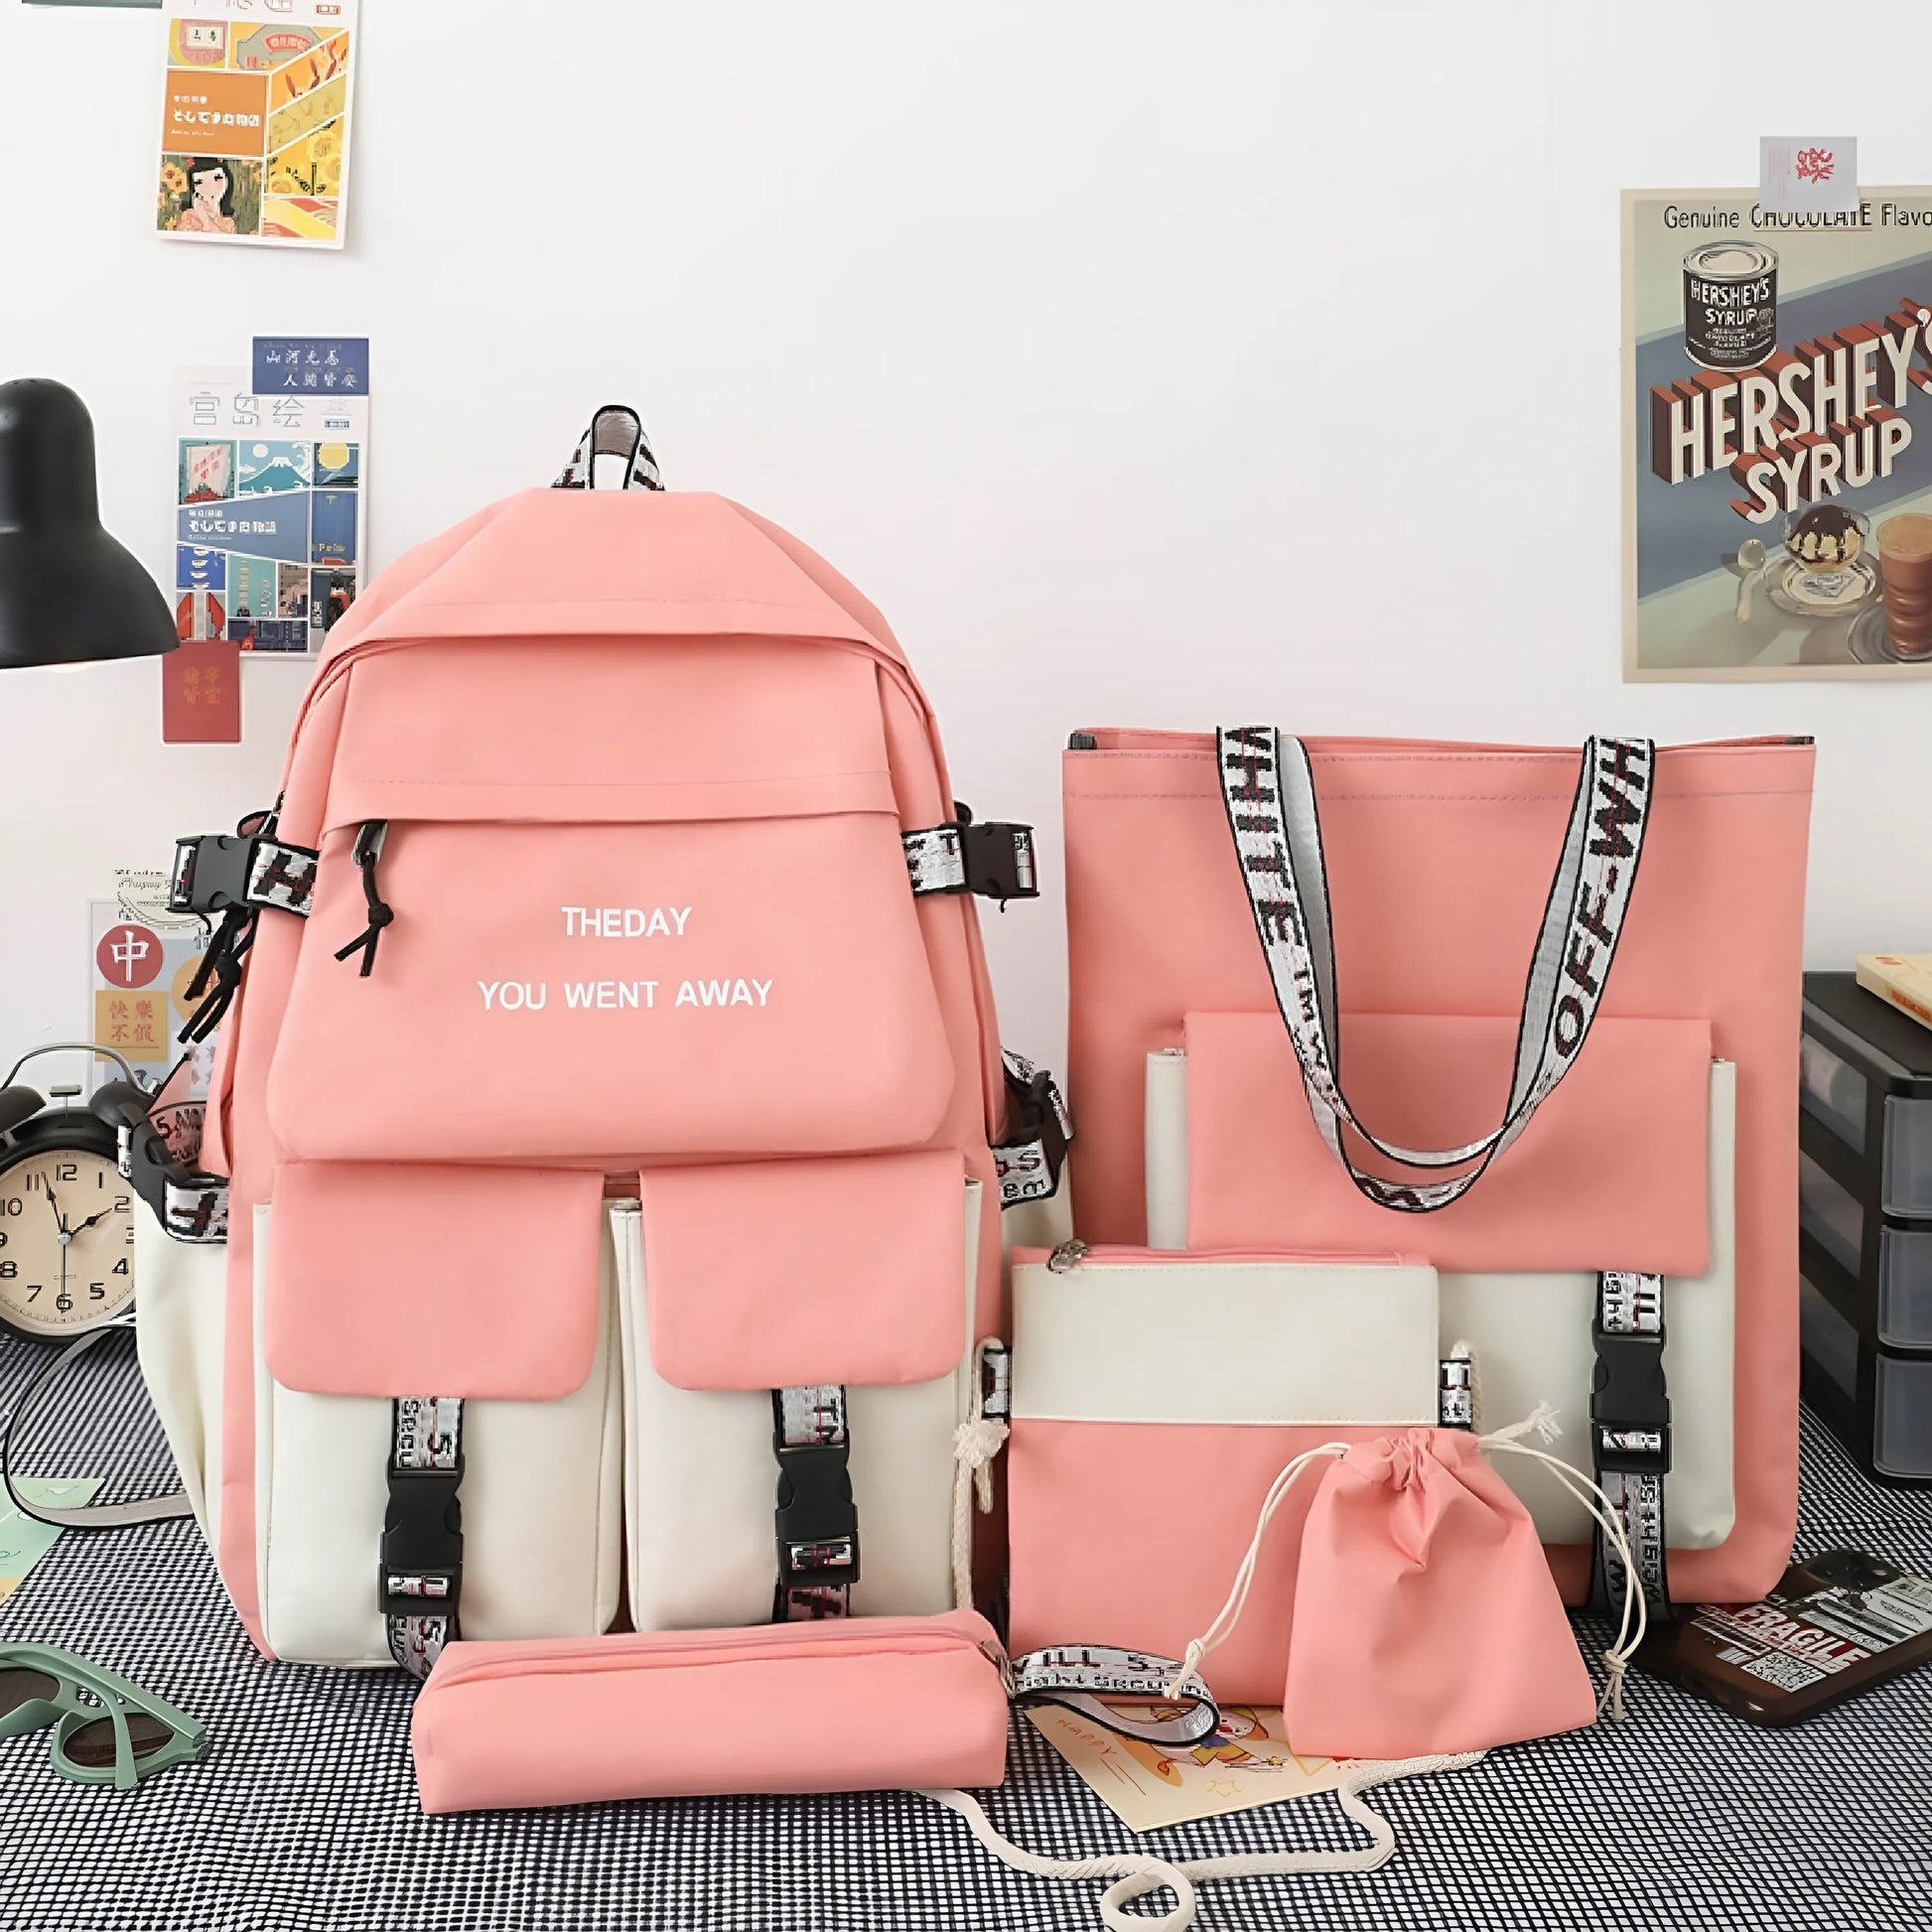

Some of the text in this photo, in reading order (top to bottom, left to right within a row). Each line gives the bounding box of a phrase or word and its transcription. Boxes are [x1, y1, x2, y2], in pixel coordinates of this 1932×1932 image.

[1664, 206, 1739, 229] Genuine
[1691, 278, 1769, 308] HERSHEY'S
[1705, 308, 1757, 326] SYRUP
[1739, 415, 1913, 525] SYRUP
[561, 906, 692, 937] THEDAY
[110, 930, 150, 982] 中
[477, 978, 773, 1011] YOU WENT AWAY
[26, 1173, 40, 1191] 11
[56, 1164, 77, 1181] 12
[0, 1197, 23, 1216] 10
[114, 1195, 131, 1213] 2
[0, 1260, 19, 1279] 8
[112, 1257, 129, 1276] 4
[26, 1285, 43, 1303] 7
[89, 1282, 105, 1301] 5
[56, 1293, 73, 1311] 6
